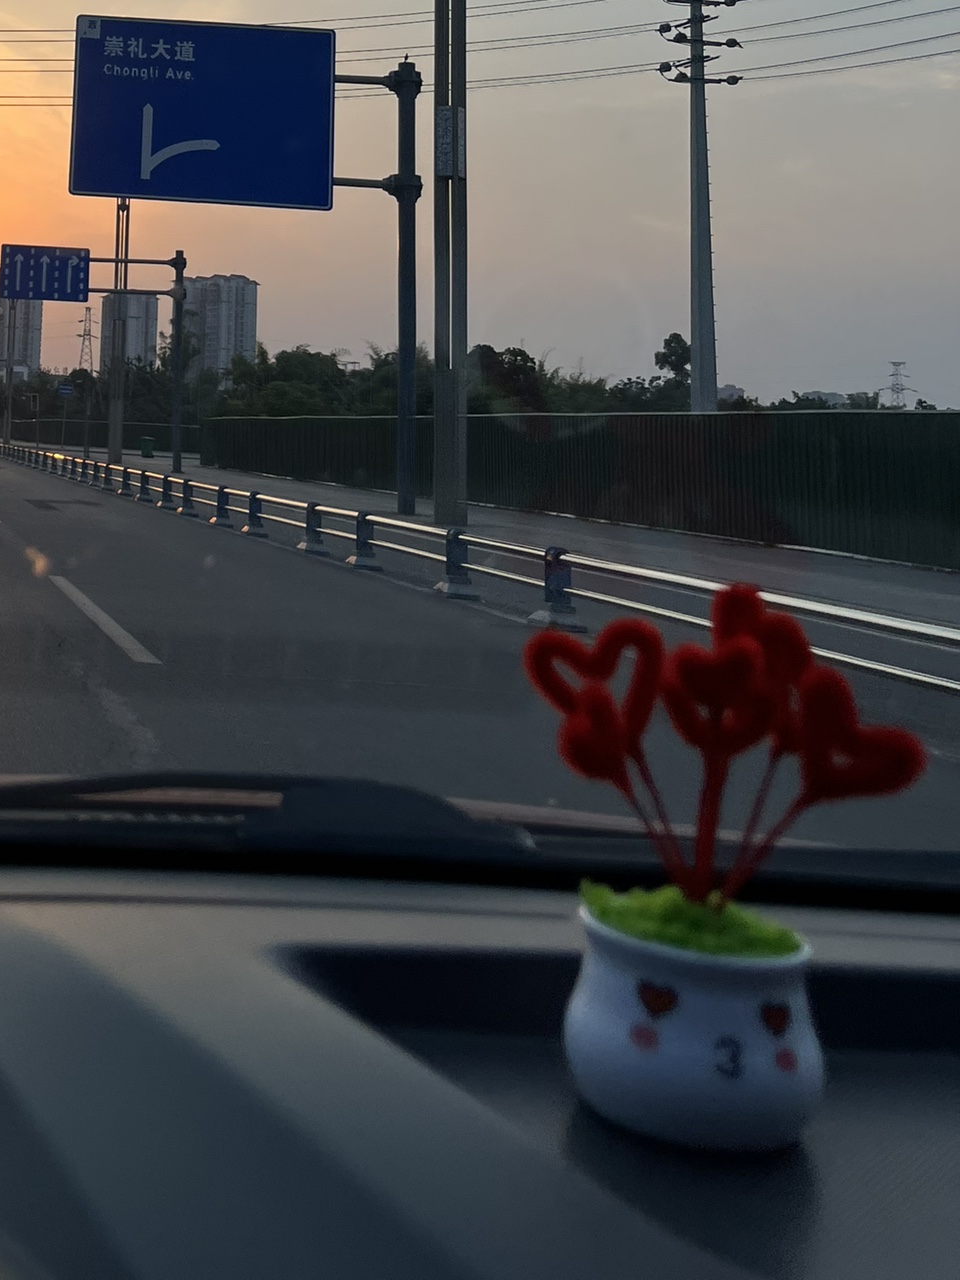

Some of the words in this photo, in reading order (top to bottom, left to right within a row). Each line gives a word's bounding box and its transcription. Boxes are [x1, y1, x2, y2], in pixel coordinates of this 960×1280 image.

[103, 35, 196, 61] 崇礼大道
[103, 63, 159, 81] Chongli
[165, 67, 194, 81] Ave.
